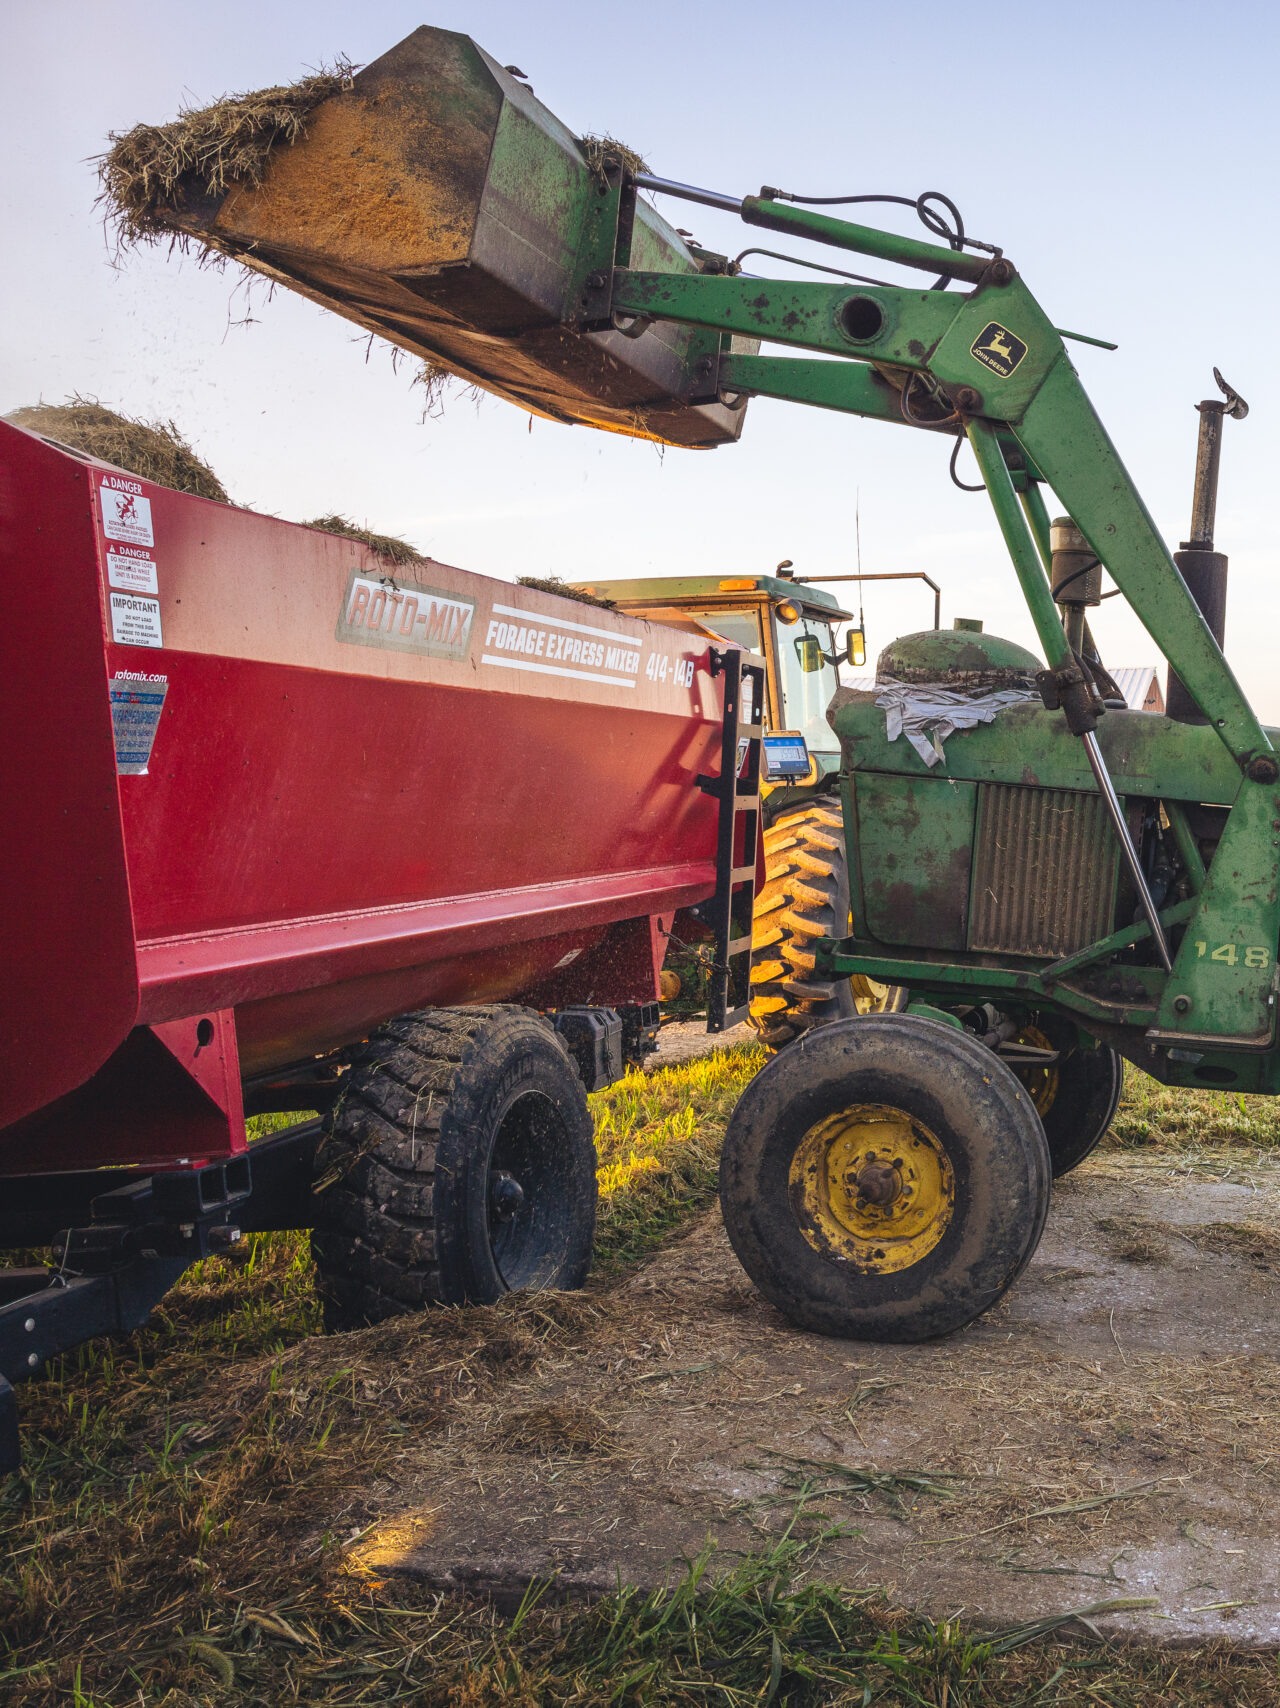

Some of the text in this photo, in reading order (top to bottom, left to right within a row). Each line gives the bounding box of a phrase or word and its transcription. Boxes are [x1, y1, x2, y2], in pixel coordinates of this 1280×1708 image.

[973, 349, 1008, 375] JOHN DEERE
[110, 477, 143, 495] DANGER
[119, 546, 150, 560] DANGER
[112, 597, 157, 614] IMPORTANT
[346, 584, 471, 646] ROTO-MIX
[485, 620, 695, 688] FORAGE EXPRESS MIXER 414-14B
[114, 669, 168, 683] rotomix.com
